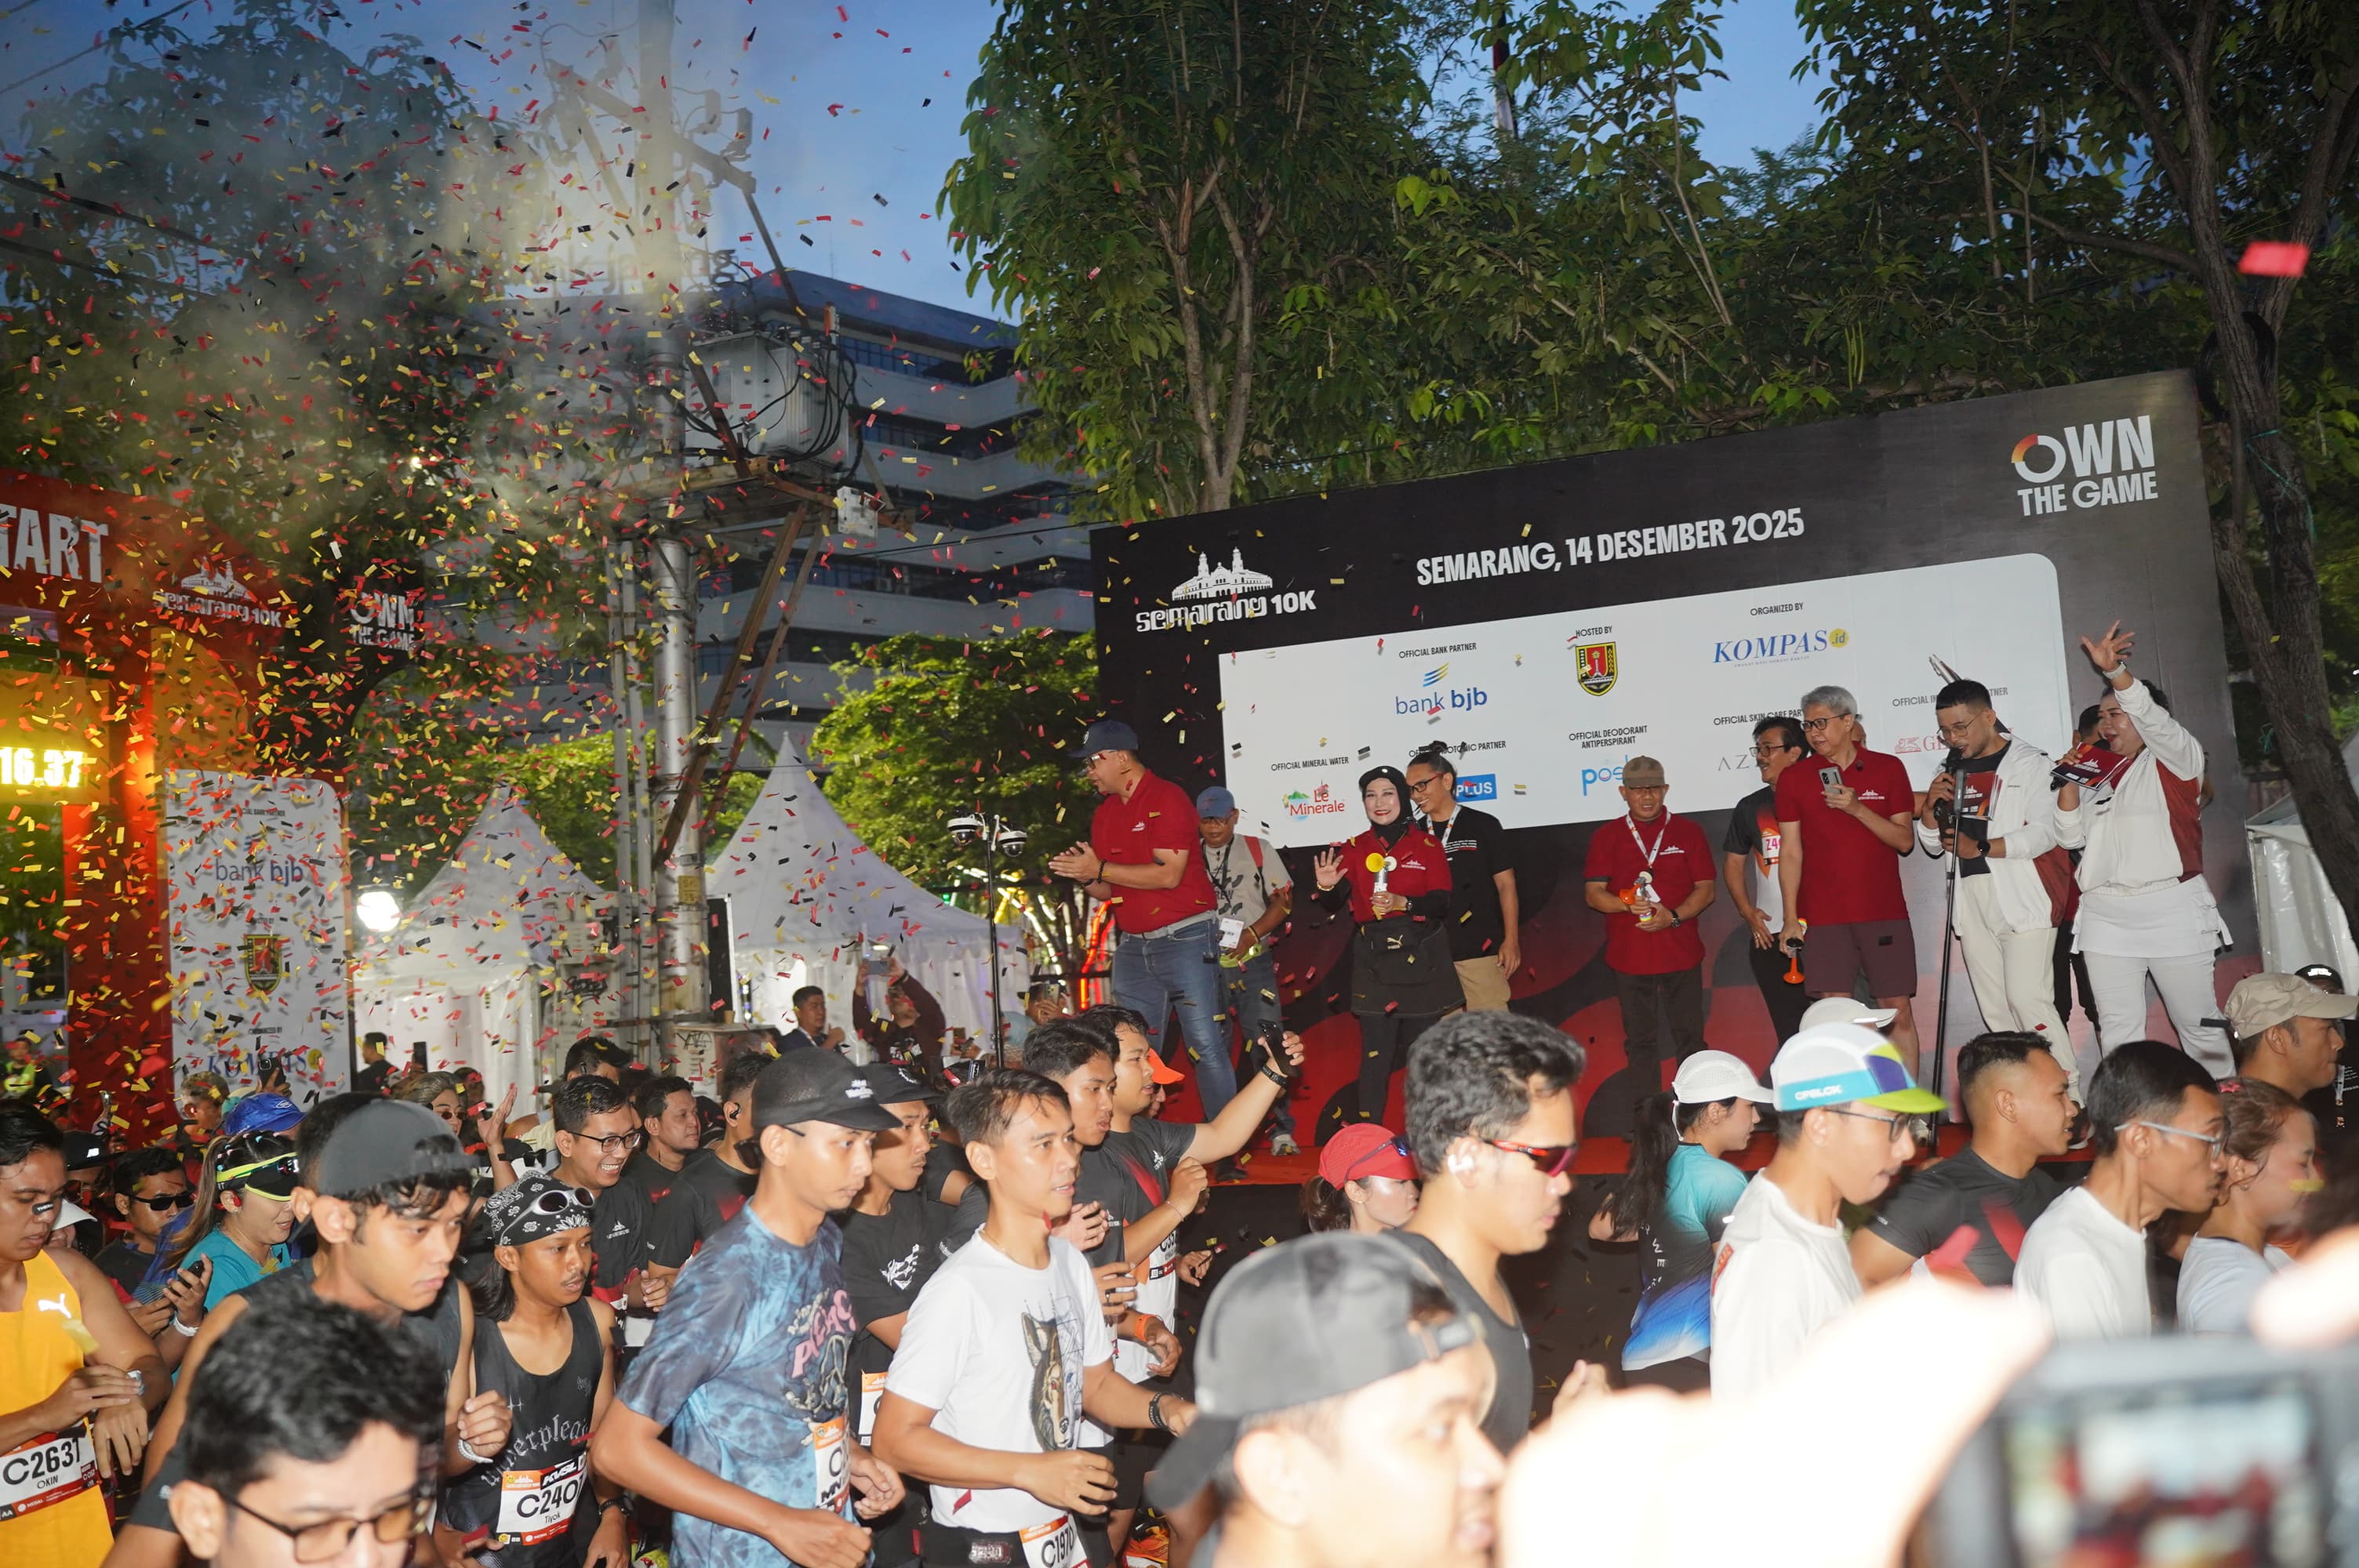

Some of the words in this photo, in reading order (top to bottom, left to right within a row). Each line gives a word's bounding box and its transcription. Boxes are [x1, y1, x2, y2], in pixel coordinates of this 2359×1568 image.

[2011, 416, 2156, 484] OWN
[2017, 482, 2067, 517] THE
[2072, 470, 2159, 510] GAME
[1416, 542, 1563, 586] SEMARANG,
[1565, 537, 1593, 566] 14
[1597, 518, 1728, 564] DESEMBER
[1731, 507, 1805, 546] 2025
[1136, 596, 1268, 633] semarang
[1270, 590, 1318, 615] 10K
[1750, 603, 1794, 616] ORGANIZED
[1794, 601, 1804, 611] BY
[251, 608, 282, 628] 10K
[1576, 626, 1603, 637] HOSTED
[1605, 626, 1613, 634] BY
[1398, 648, 1430, 659] OFFICIAL
[1431, 645, 1448, 655] BANK
[1449, 642, 1478, 653] PARTNER
[1712, 629, 1828, 663] KOMPAS
[1988, 687, 2008, 698] TNER
[1395, 691, 1445, 715] bank
[1451, 687, 1488, 712] bjb
[1892, 695, 1929, 707] OFFICIAL
[1713, 714, 1749, 726] OFFICIAL
[1568, 731, 1602, 742] OFFICIAL
[1603, 725, 1648, 738] DEODORANT
[1478, 741, 1507, 751] PARTNER
[1581, 735, 1637, 750] ANTIPERSPIRANT
[1270, 762, 1301, 771] OFFICIAL
[1302, 758, 1329, 768] MINERAL
[1329, 756, 1350, 766] WATER
[1581, 754, 1629, 797] pos
[1314, 789, 1329, 803] Le
[1290, 800, 1346, 816] Minerale
[271, 859, 304, 887] bjb
[37, 1475, 59, 1490] OKIN
[545, 1512, 561, 1524] Tiyok
